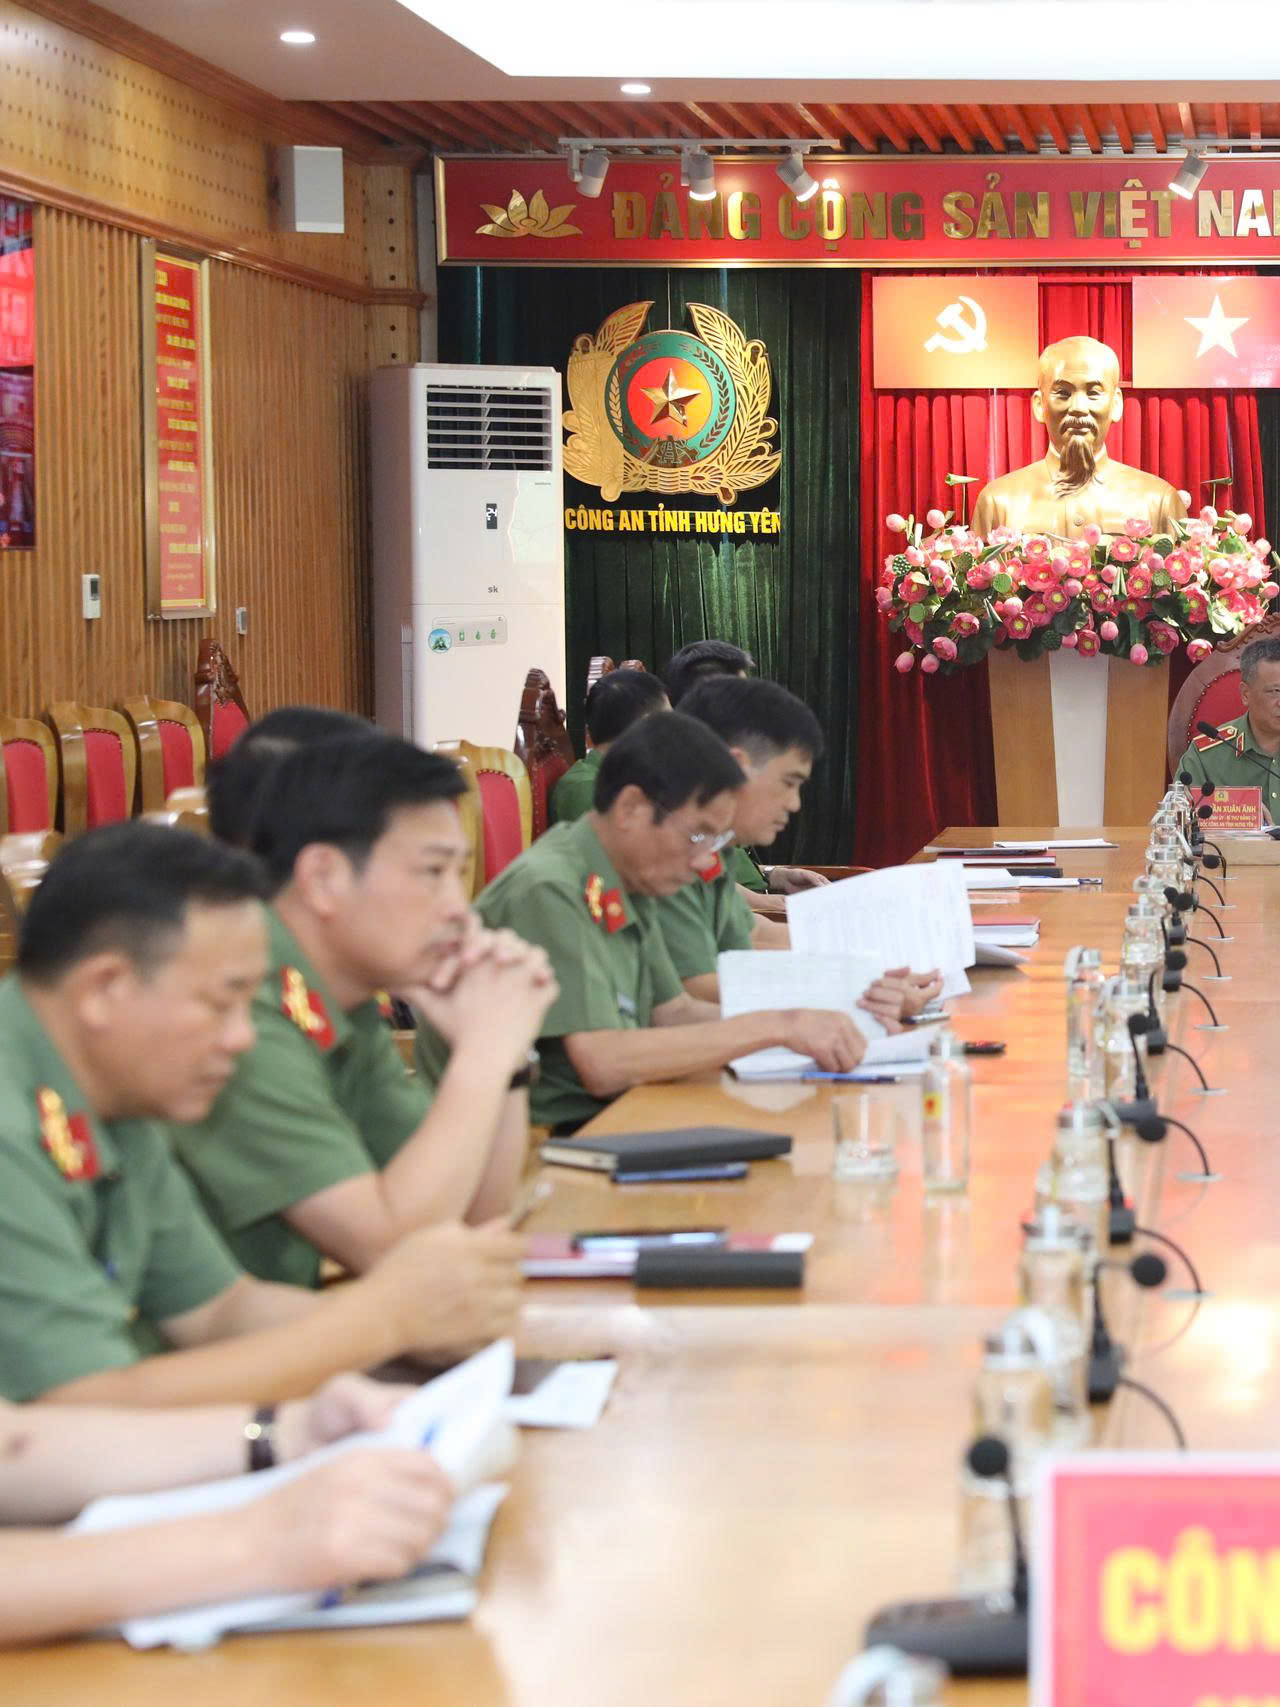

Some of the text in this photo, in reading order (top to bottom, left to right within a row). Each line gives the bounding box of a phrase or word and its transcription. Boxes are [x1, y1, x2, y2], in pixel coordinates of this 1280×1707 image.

[611, 172, 761, 240] ĐẢNG
[778, 177, 925, 252] CỘNG
[943, 172, 1051, 239] SẢN
[1070, 178, 1184, 249] VIỆT
[564, 504, 614, 531] CÔNG
[618, 510, 645, 531] AN
[648, 503, 691, 532] TỈNH
[695, 510, 746, 533] HƯNG
[1223, 803, 1241, 813] XUÂN
